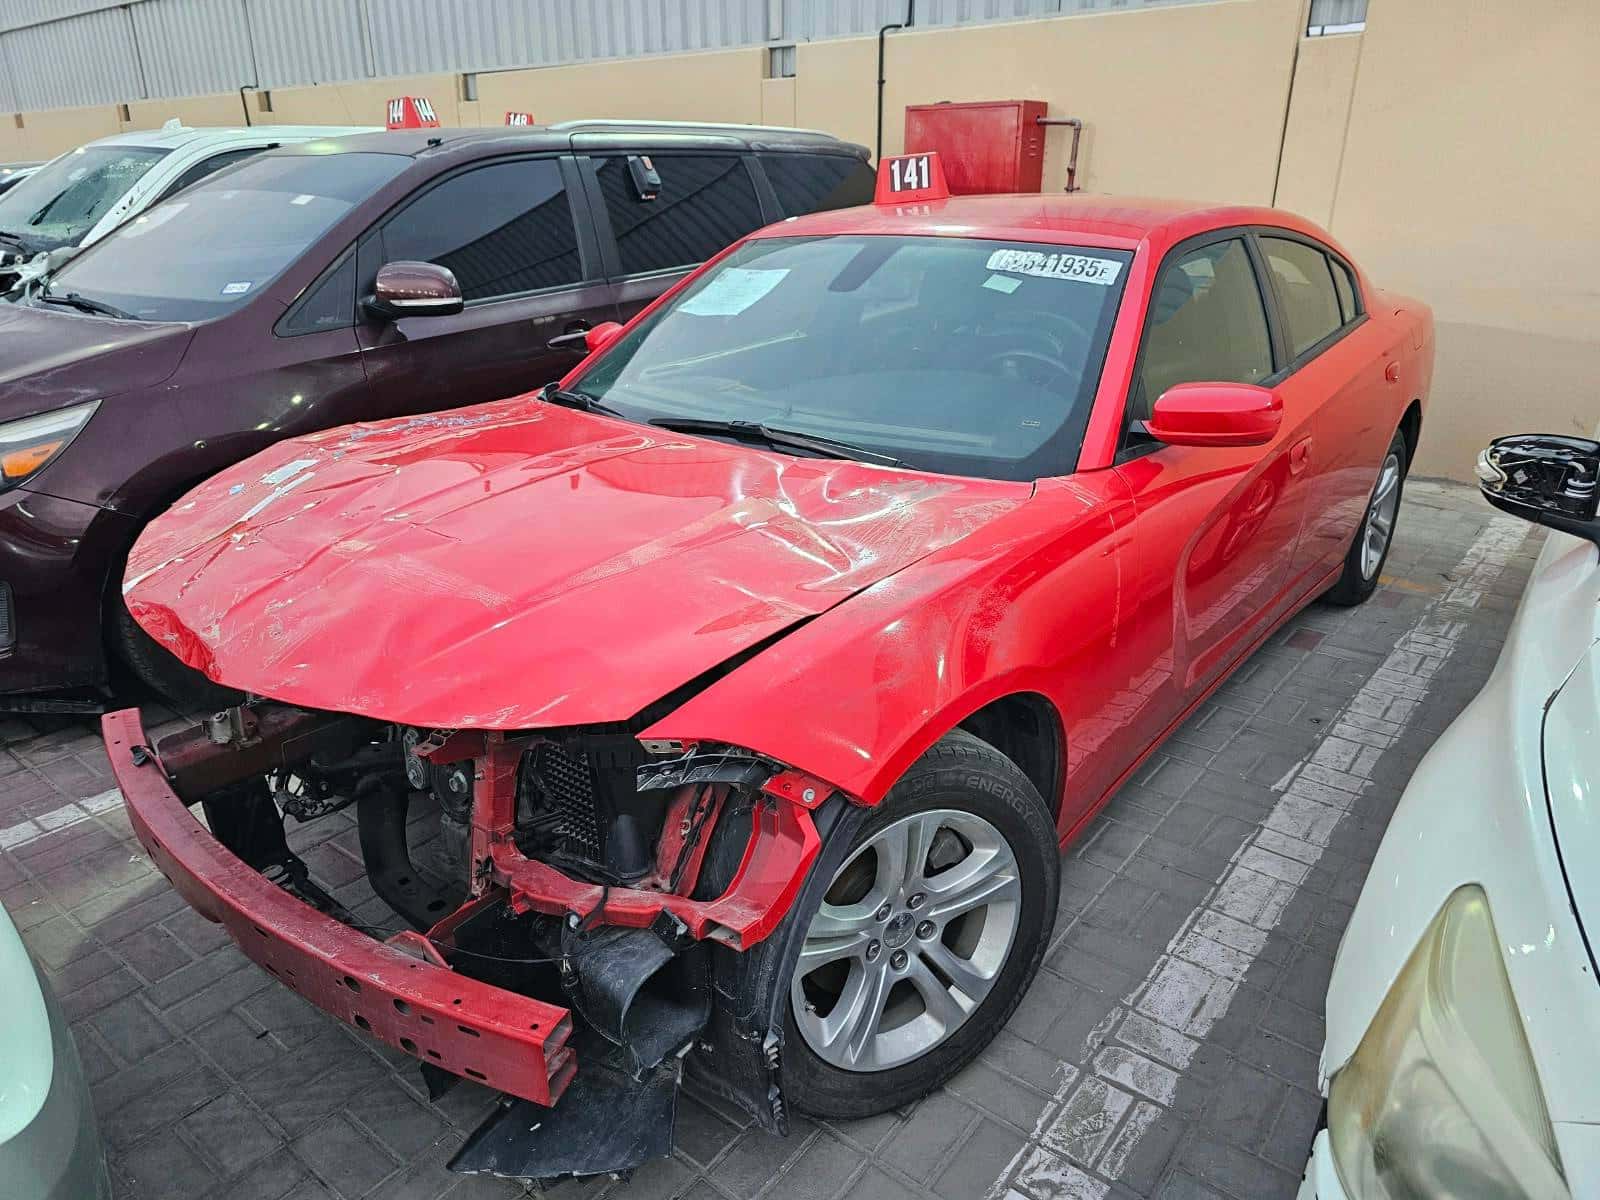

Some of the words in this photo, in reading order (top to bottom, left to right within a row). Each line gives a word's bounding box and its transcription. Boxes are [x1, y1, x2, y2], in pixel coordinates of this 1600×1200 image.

[389, 98, 404, 124] 144
[891, 156, 929, 192] 141
[966, 775, 1034, 820] ENERGY
